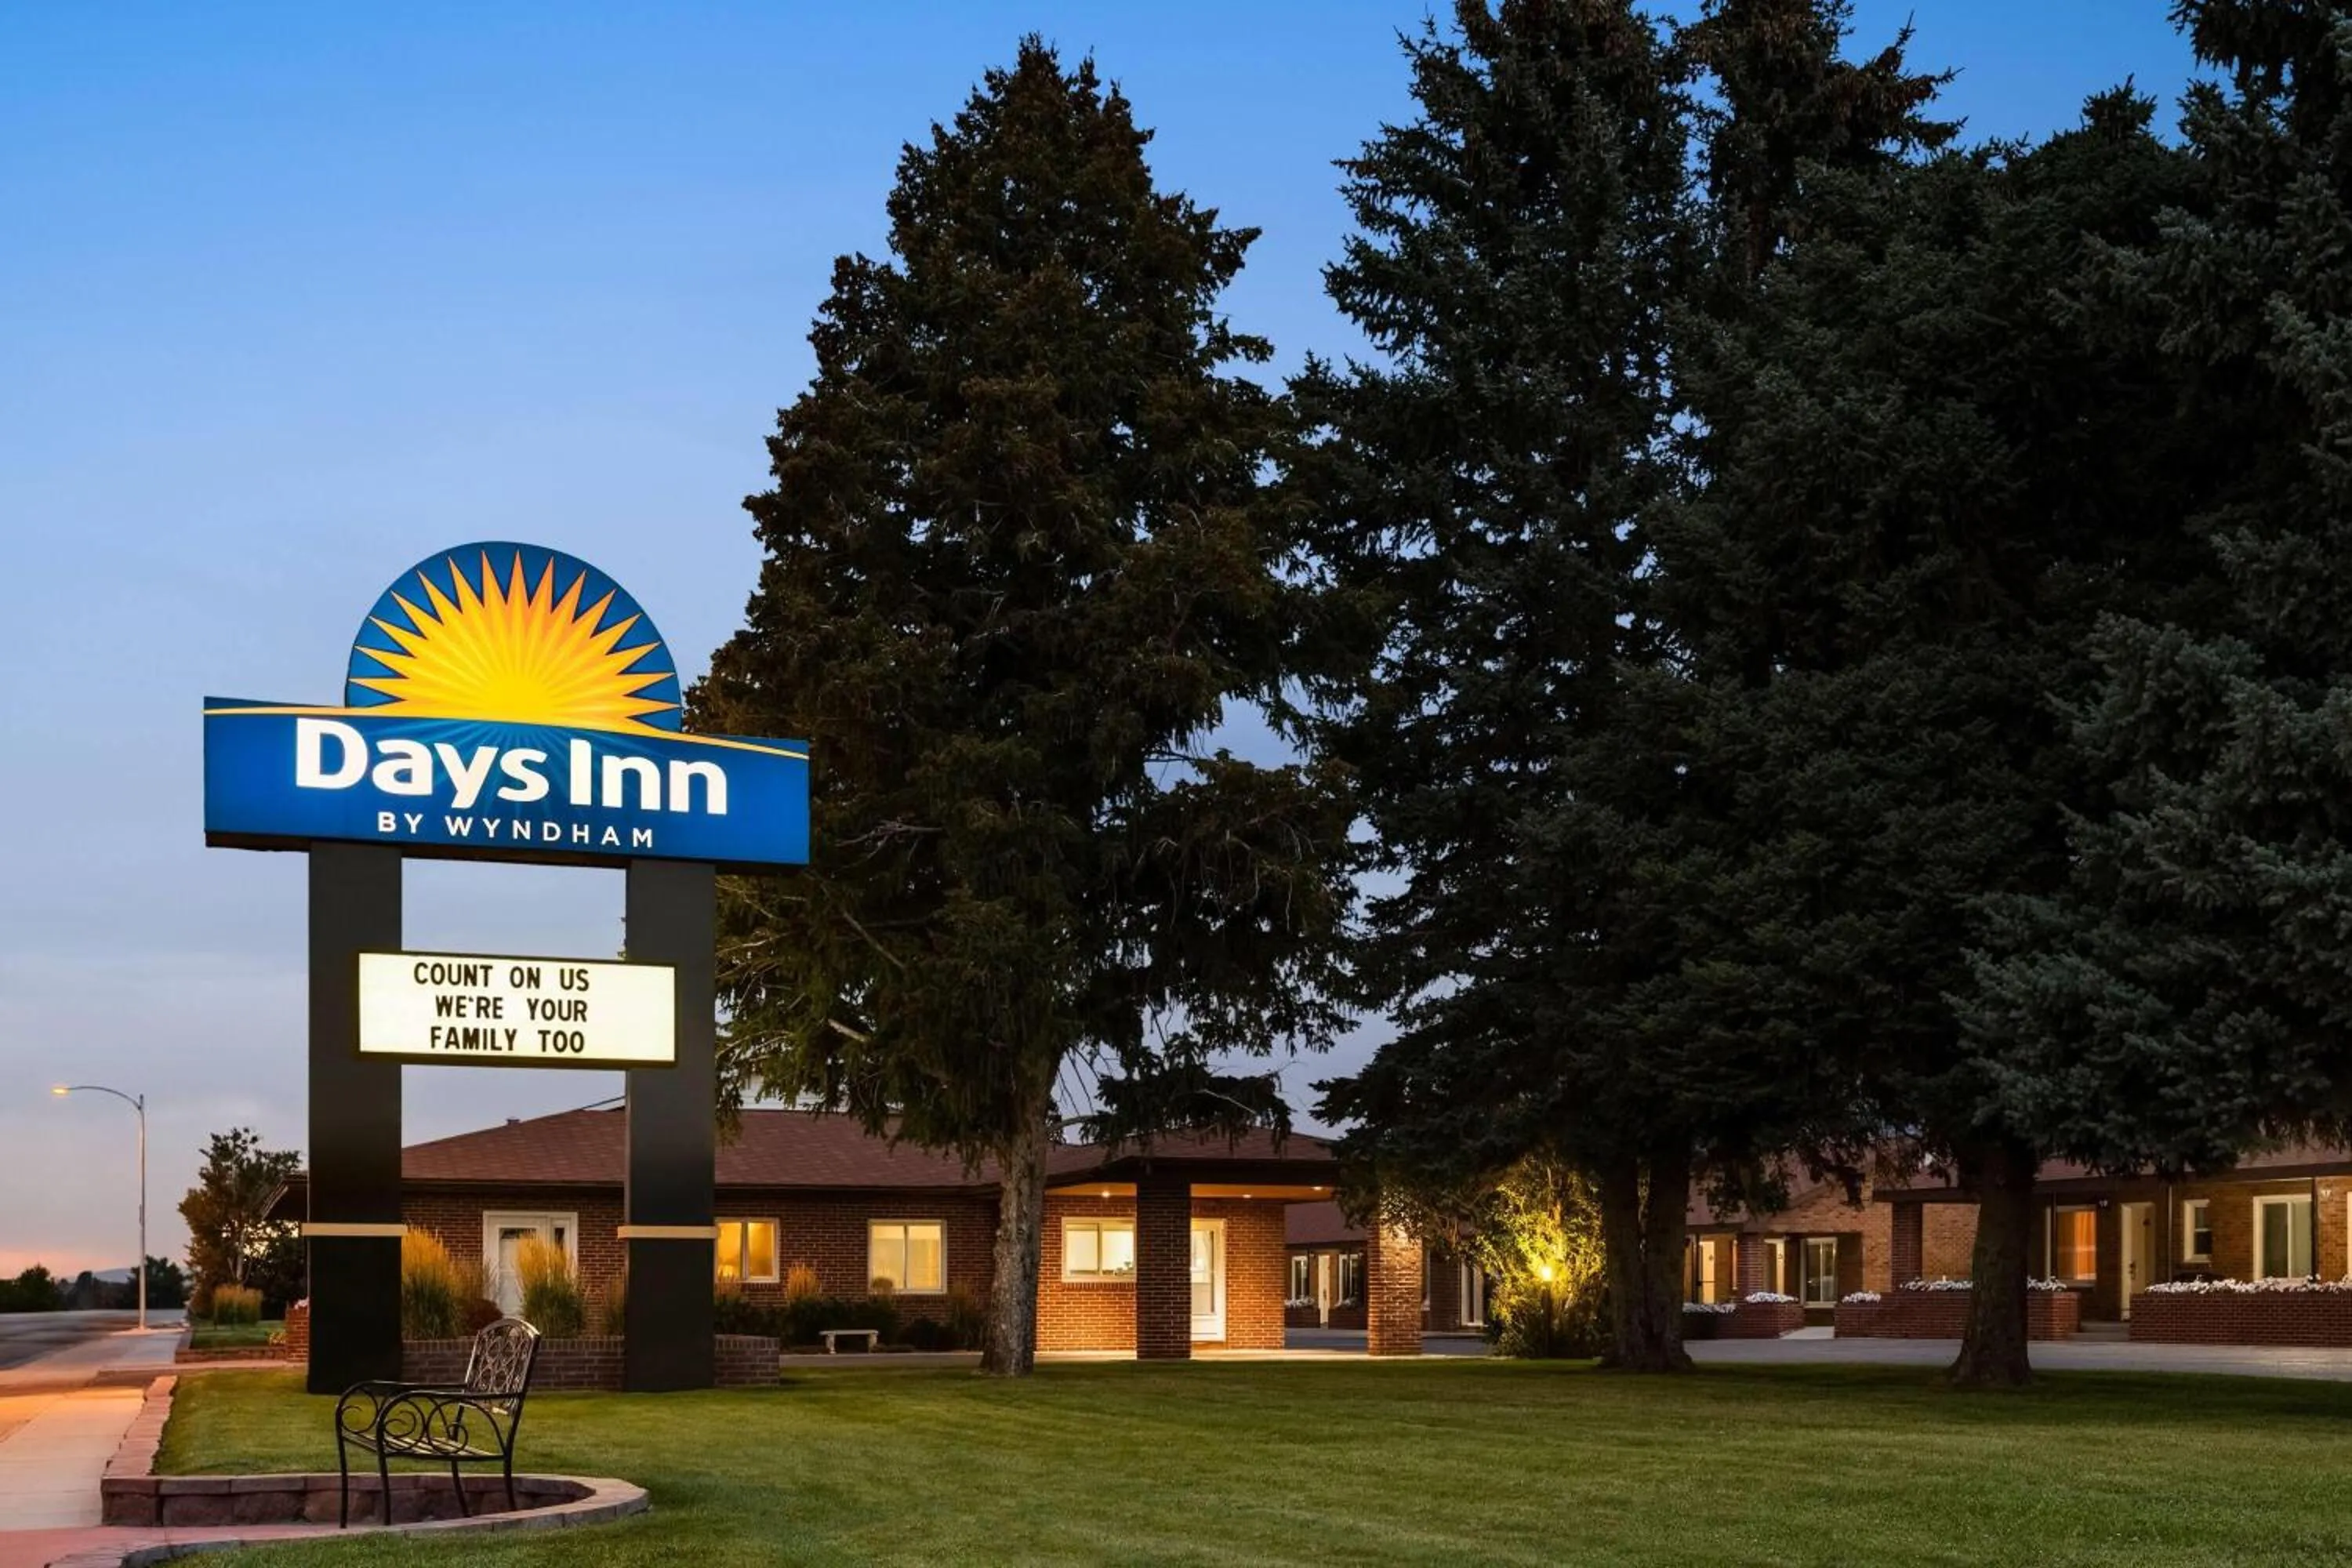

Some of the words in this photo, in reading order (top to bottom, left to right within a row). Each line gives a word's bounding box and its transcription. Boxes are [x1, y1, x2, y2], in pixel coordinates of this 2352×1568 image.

[296, 717, 550, 809] Days
[570, 739, 728, 815] Inn
[378, 811, 423, 834] BY
[445, 815, 652, 848] WYNDHAM
[413, 962, 493, 988] COUNT
[510, 966, 540, 989] ON
[560, 968, 590, 992] US
[435, 995, 503, 1019] WE'RE
[526, 998, 588, 1022] YOUR
[430, 1025, 517, 1051] FAMILY
[537, 1029, 585, 1054] TOO
